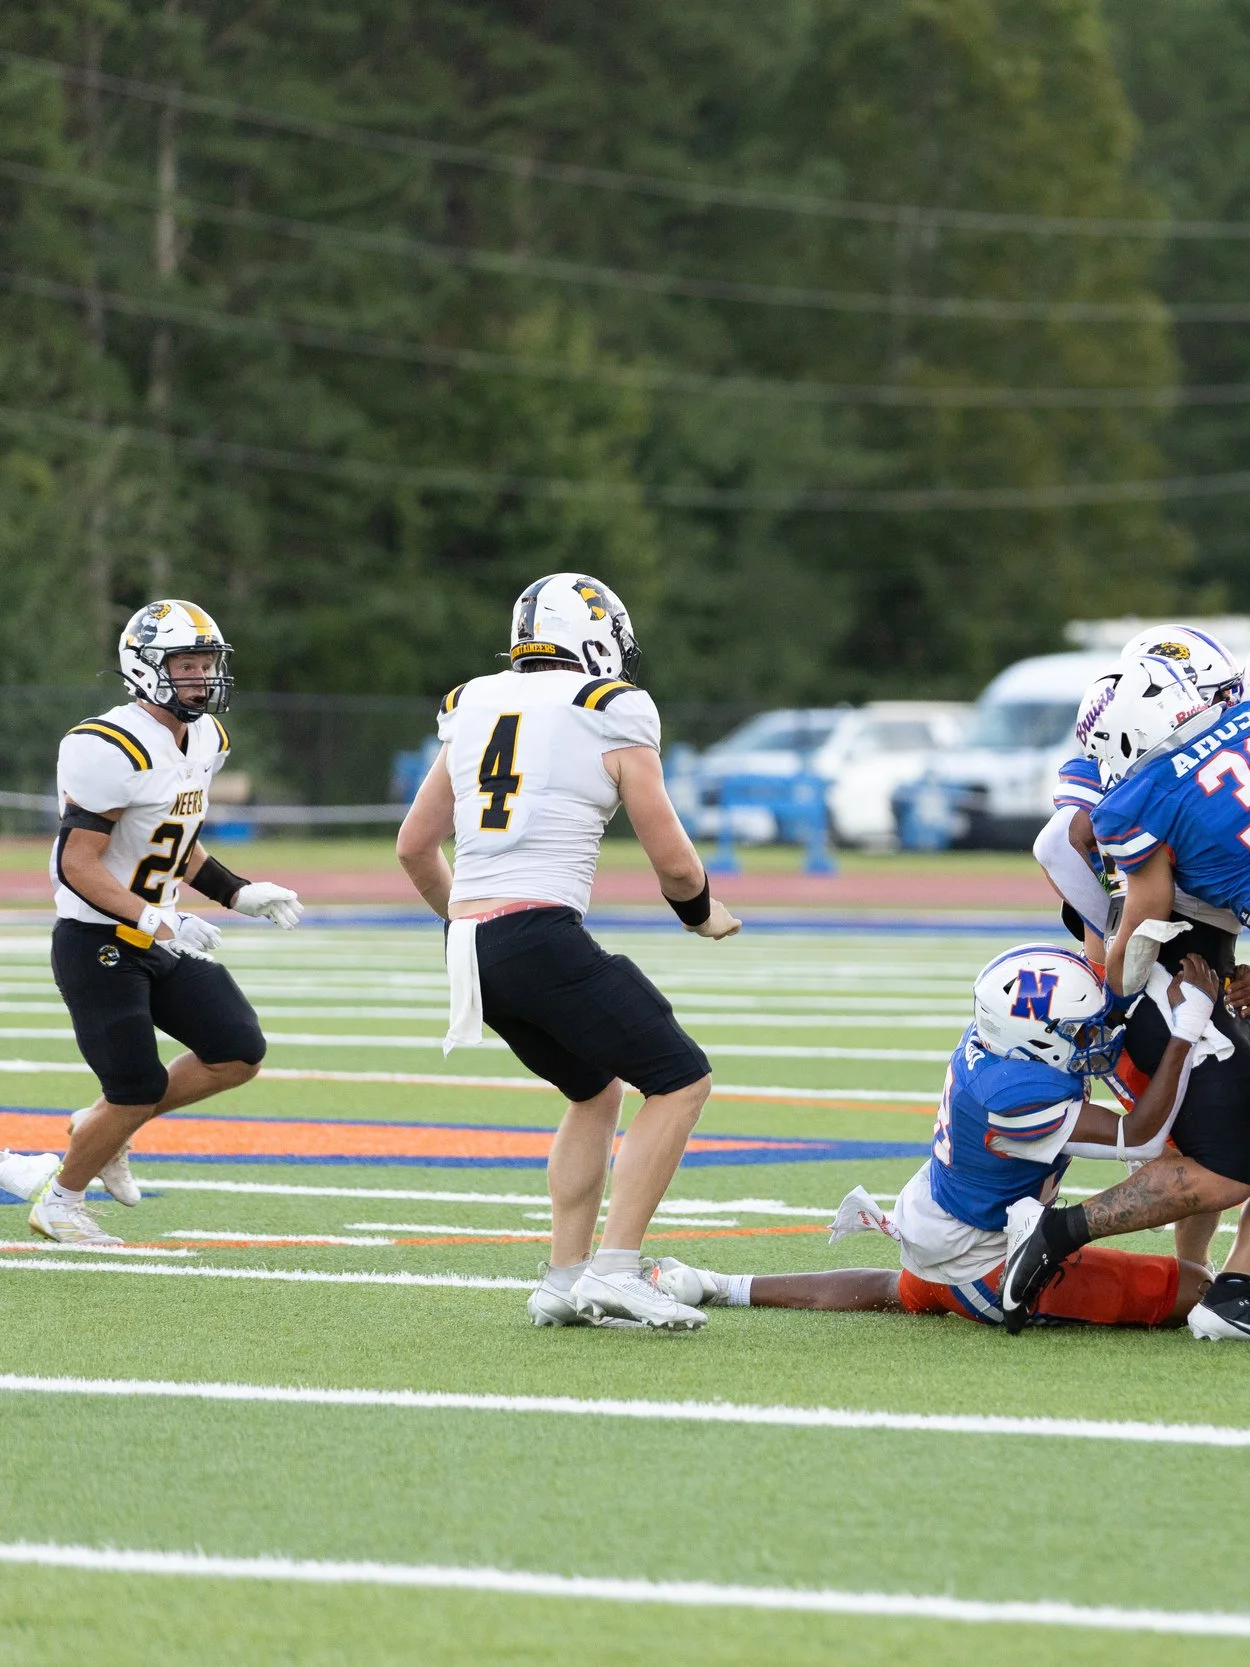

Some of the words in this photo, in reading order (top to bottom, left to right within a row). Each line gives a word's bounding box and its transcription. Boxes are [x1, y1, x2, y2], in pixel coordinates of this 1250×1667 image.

[1076, 686, 1116, 748] Bruins
[478, 711, 523, 832] 4
[1010, 968, 1060, 1022] N
